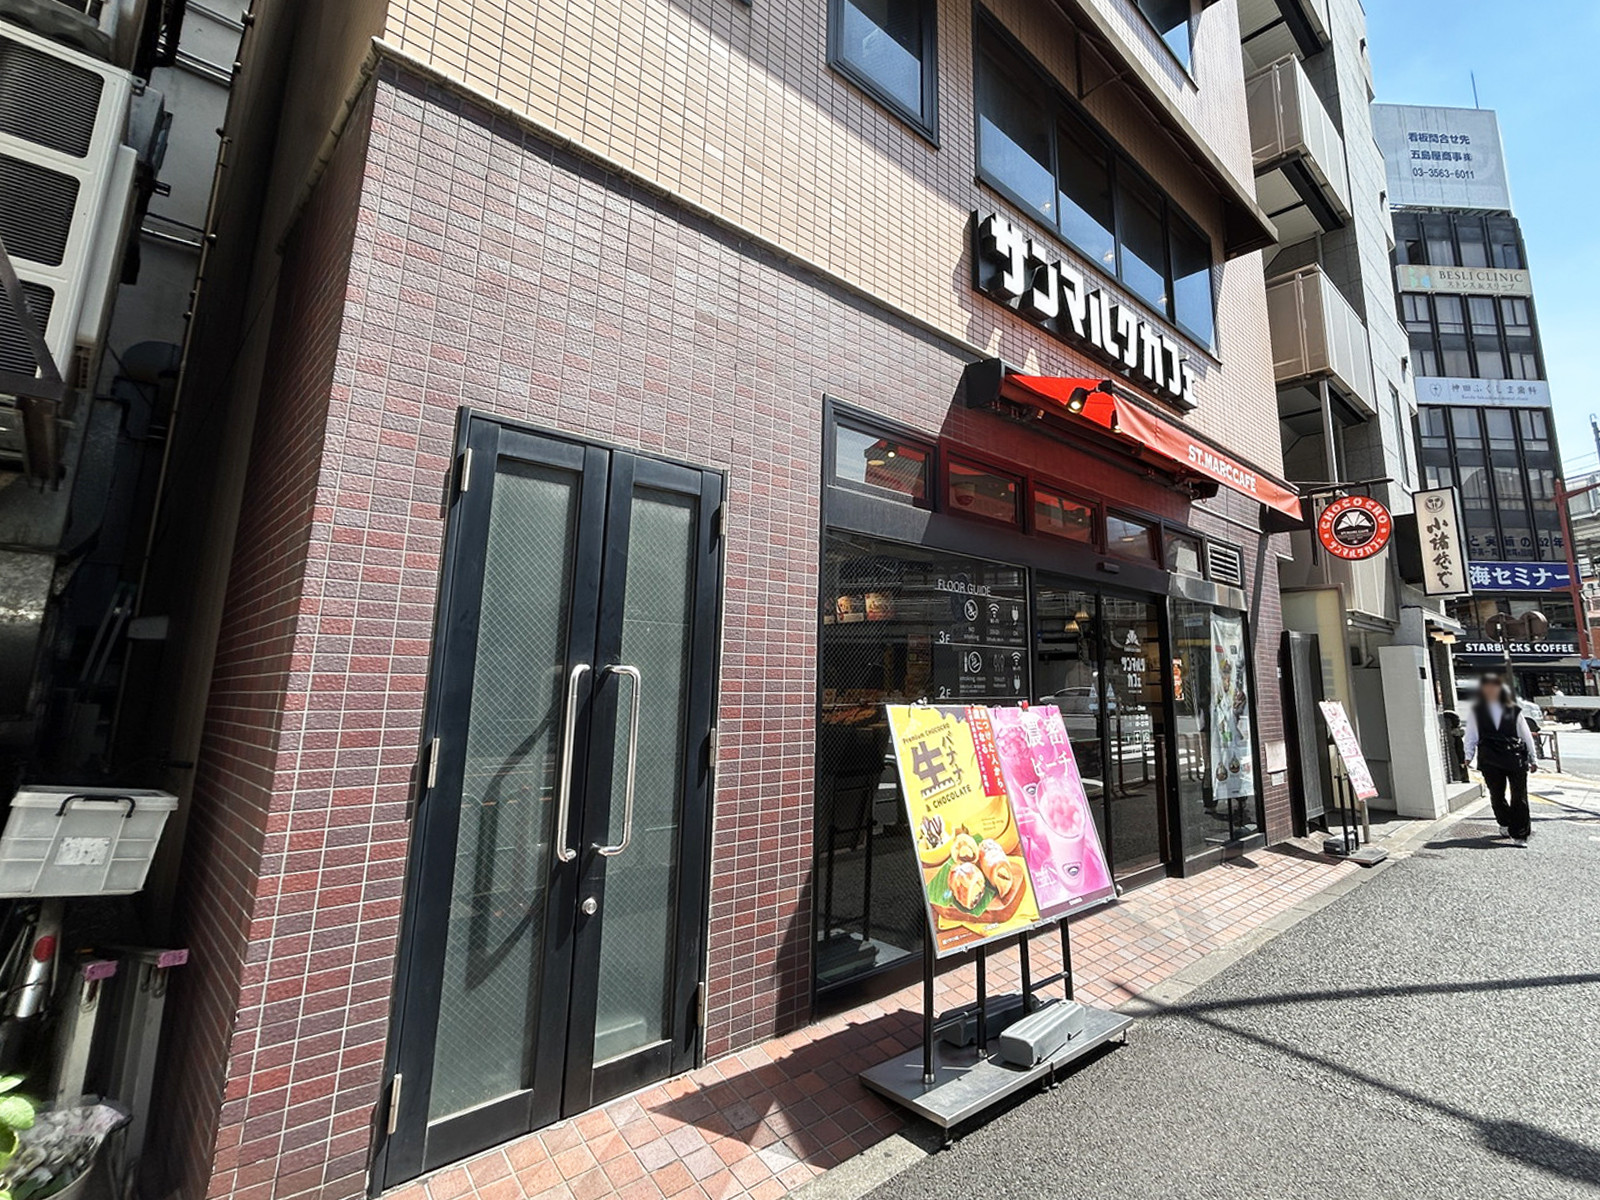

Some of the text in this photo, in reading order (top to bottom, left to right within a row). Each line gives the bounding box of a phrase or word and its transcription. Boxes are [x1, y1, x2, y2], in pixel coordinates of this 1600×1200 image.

[1408, 132, 1470, 145] 看板問合せ先
[1412, 167, 1475, 179] 03-3563-6011
[1439, 270, 1524, 283] BESLI CLINIC
[991, 212, 1197, 408] サンマルクカフェ
[1469, 565, 1571, 587] 海セミナー
[938, 579, 991, 597] FLOOR GUIDE
[939, 631, 950, 644] 3F
[1465, 642, 1574, 653] STARBCKS COFFEE
[939, 687, 950, 699] 2F
[941, 731, 965, 787] バナナ
[1030, 751, 1072, 777] ピーチ
[911, 741, 956, 800] 生
[932, 784, 972, 809] CHOCOLATE
